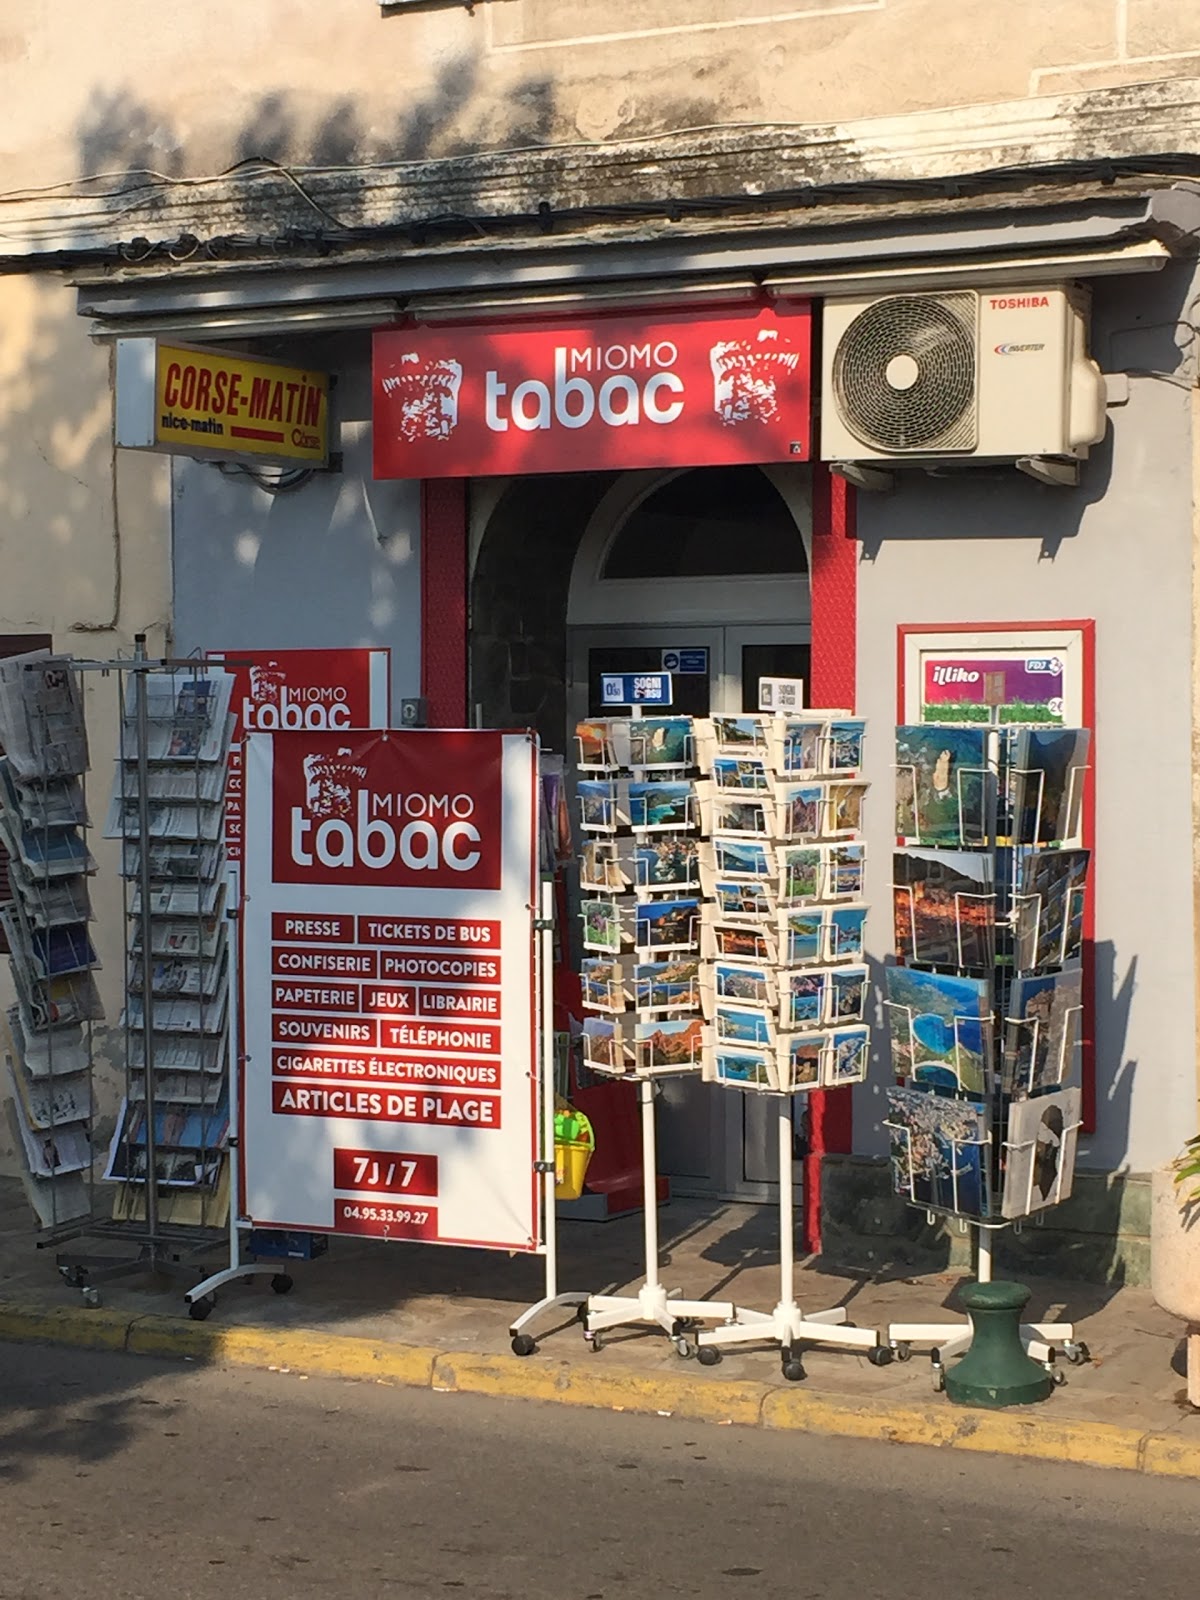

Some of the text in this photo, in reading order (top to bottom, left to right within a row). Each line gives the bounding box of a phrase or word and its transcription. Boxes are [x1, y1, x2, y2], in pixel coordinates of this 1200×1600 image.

[990, 297, 1049, 310] TOSHIBA
[571, 341, 677, 372] MIOMO
[164, 362, 323, 427] CORSE-MATIN
[485, 346, 685, 431] tabac
[161, 412, 224, 435] nice-matin
[1028, 661, 1047, 670] FDJ
[932, 666, 980, 686] illiko
[288, 687, 347, 702] MIOMO
[242, 686, 351, 729] tabac
[372, 793, 474, 818] MIOMO
[291, 789, 481, 872] tabac
[285, 919, 340, 937] PRESSE
[368, 922, 491, 942] TICKETS DE BUS
[278, 953, 371, 972] CONFISERIE
[384, 958, 497, 977] PHOTOCOPIES
[275, 987, 355, 1006] PAPETERIE
[369, 991, 409, 1008] JEUX
[423, 994, 497, 1013] LIBRAIRIE
[278, 1021, 370, 1041] SOUVENIRS
[390, 1024, 492, 1049] TÉLÉPHONIE
[276, 1055, 496, 1084] CIGARETTES ÉLECTRONIQUES
[280, 1088, 493, 1122] ARTICLES DE PLAGE
[353, 1157, 379, 1185] 7J
[401, 1161, 417, 1187] 7
[343, 1206, 428, 1225] 04.95.33.99.27
